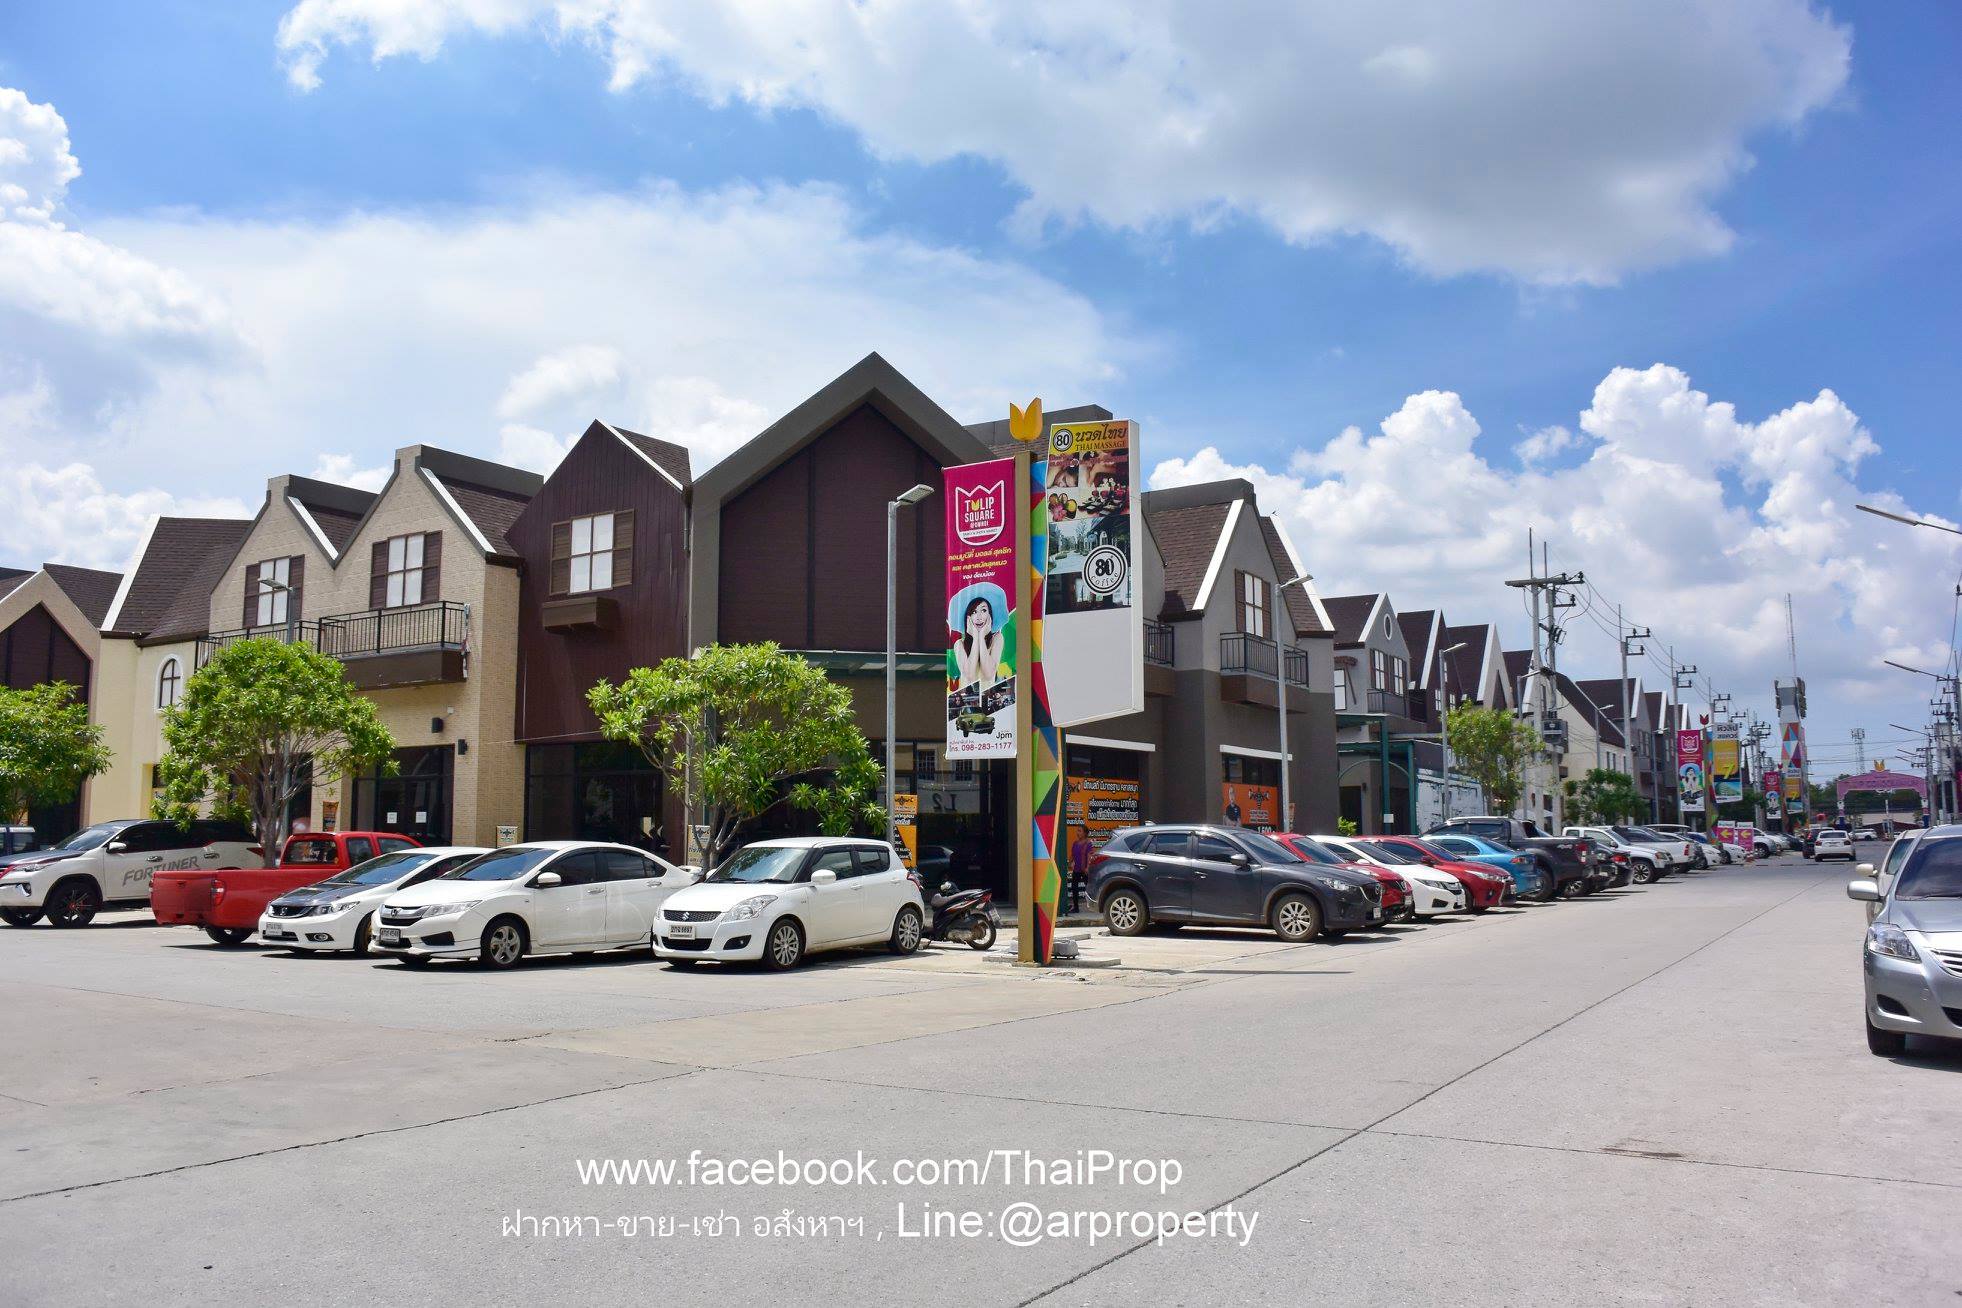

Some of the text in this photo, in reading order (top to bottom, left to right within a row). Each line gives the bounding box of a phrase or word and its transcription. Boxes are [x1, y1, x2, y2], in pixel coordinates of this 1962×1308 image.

[1056, 434, 1070, 447] 80
[1075, 424, 1127, 442] นวดไทย
[1075, 440, 1126, 451] THAI MASSAGE
[964, 496, 995, 512] TULIP
[964, 509, 995, 523] SQUARE
[1095, 558, 1115, 576] 80
[961, 741, 1013, 752] 098-283-1177
[121, 856, 200, 887] FORTUNER
